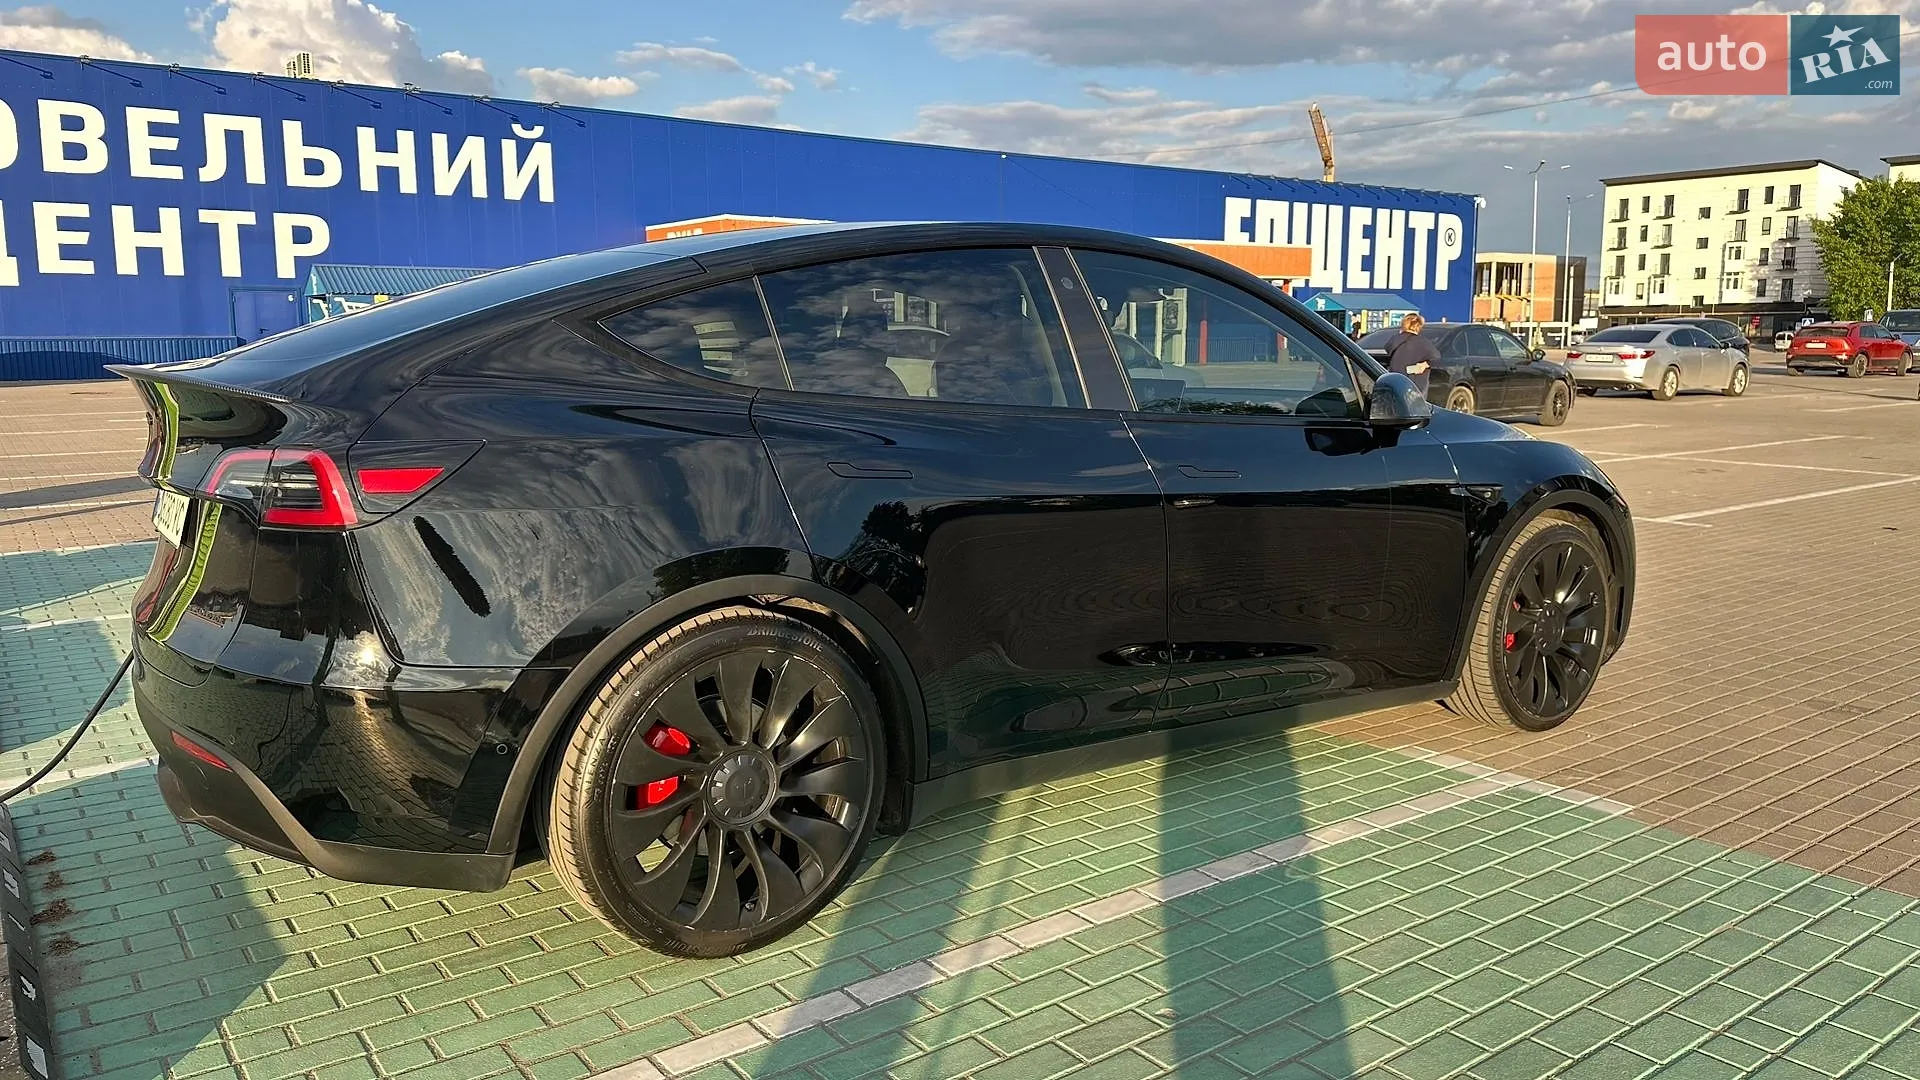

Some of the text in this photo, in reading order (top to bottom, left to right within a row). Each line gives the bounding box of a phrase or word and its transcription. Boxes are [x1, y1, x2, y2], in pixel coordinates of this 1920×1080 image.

[0, 98, 555, 203] ВЕЛЬНИЙ
[0, 200, 331, 286] ЕНТР
[747, 626, 824, 652] BRIDGESTONE
[585, 738, 606, 795] ALENZA
